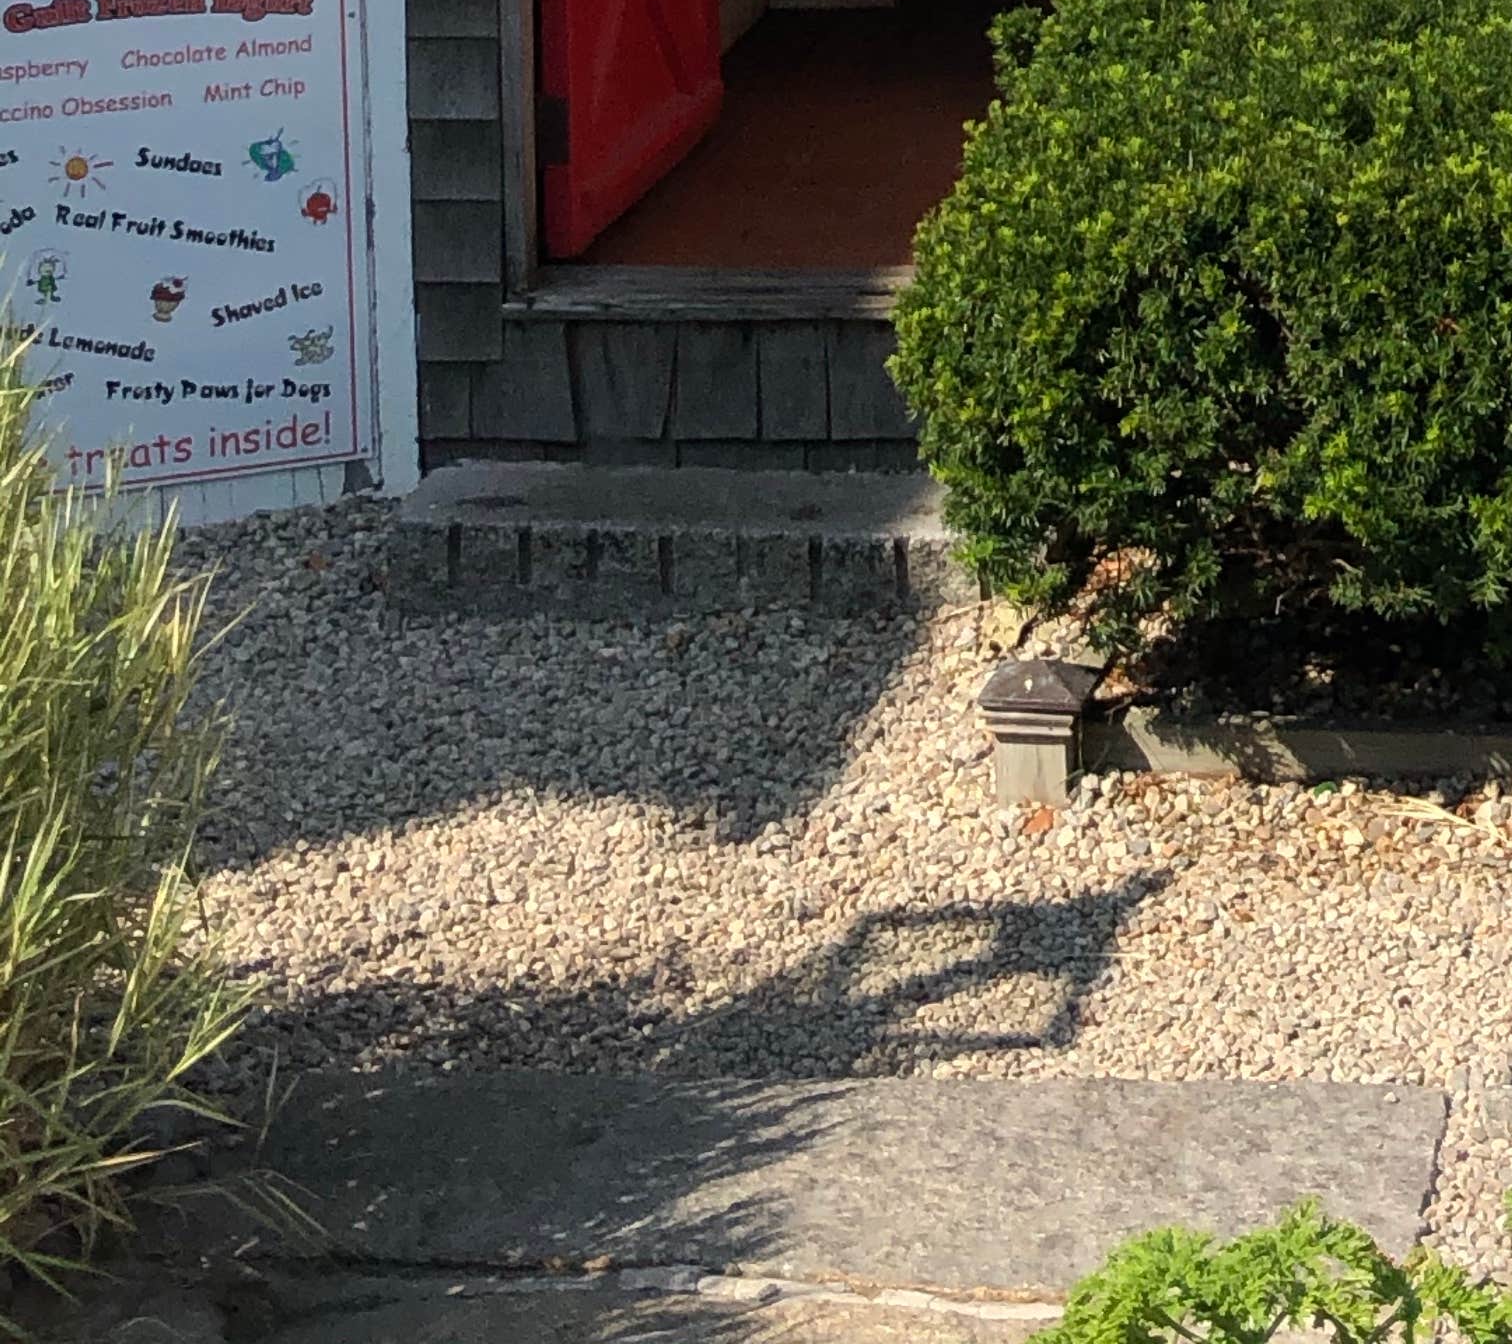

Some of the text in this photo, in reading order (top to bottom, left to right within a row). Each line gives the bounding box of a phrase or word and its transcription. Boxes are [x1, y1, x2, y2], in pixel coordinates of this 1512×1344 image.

[121, 34, 312, 70] Chocolate Almond
[61, 92, 173, 118] Obsession
[203, 78, 305, 105] Mint Chip
[135, 145, 222, 177] Sundaes
[55, 203, 275, 254] Real Fruit Smoothies
[211, 280, 324, 328] Shaved Ice
[49, 326, 156, 363] Lemonade
[105, 377, 332, 406] Frosty Paws for Dogs
[208, 409, 332, 459] inside!
